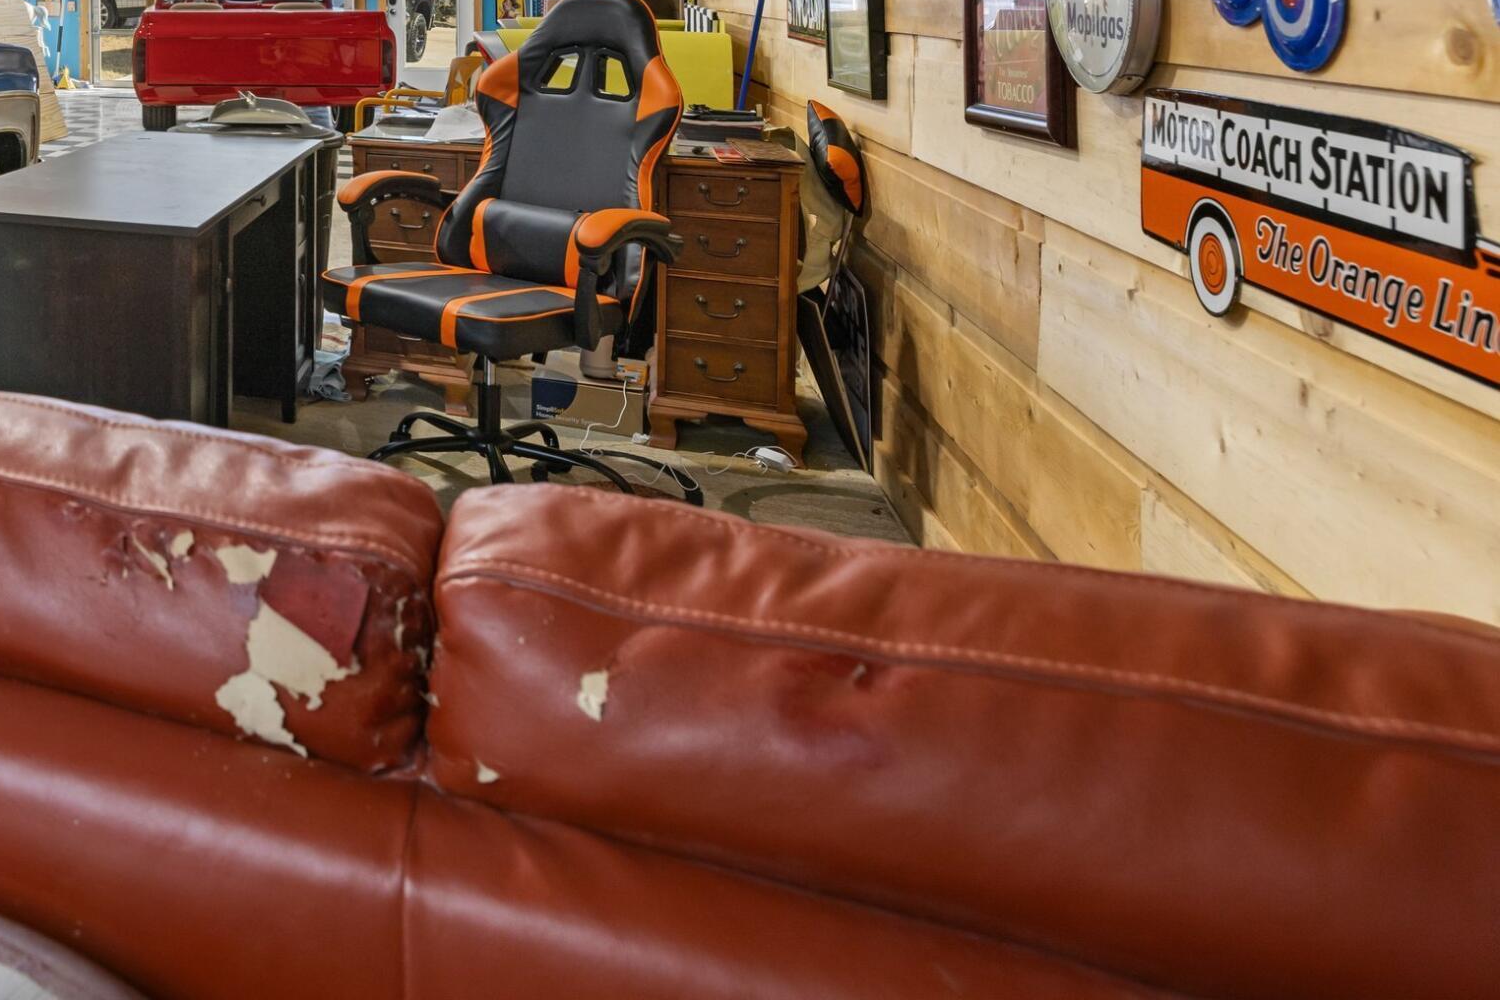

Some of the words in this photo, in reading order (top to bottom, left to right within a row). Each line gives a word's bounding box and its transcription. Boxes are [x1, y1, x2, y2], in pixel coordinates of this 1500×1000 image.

[1067, 1, 1124, 48] Mobilgas
[996, 81, 1035, 104] TOBACCO
[1151, 103, 1216, 161] MOTOR
[1220, 118, 1301, 184] COACH
[1310, 136, 1450, 224] STATION
[1256, 216, 1303, 275] The
[1308, 235, 1425, 327] Orange
[1430, 276, 1500, 356] Lin
